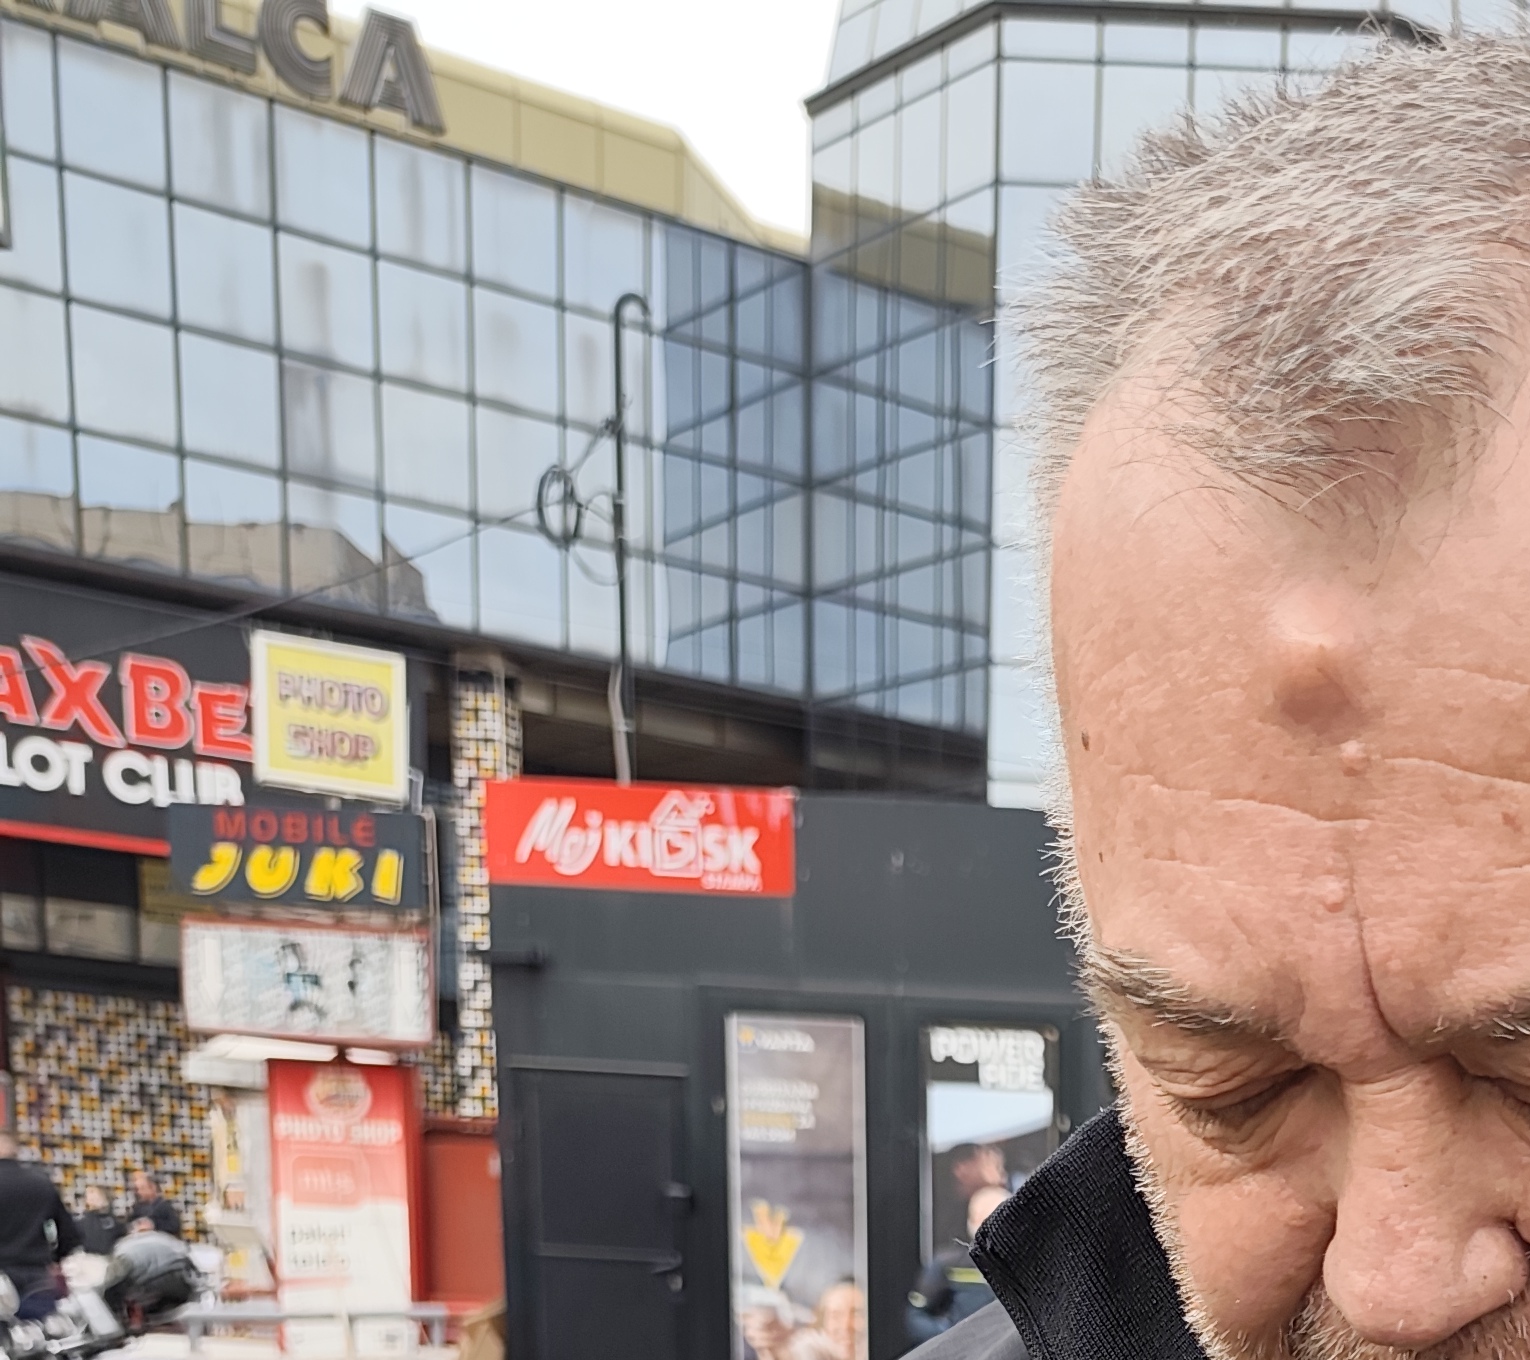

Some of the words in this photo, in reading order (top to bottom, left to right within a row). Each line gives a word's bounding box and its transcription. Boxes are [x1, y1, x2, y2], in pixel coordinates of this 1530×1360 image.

[14, 0, 448, 136] LCA
[0, 634, 254, 763] AXBE
[277, 670, 391, 723] PHOTO
[285, 722, 382, 767] SHOP
[103, 750, 245, 807] CLUB
[213, 808, 377, 848] MOBILE
[515, 797, 603, 876] Moj
[191, 841, 404, 906] JUKI
